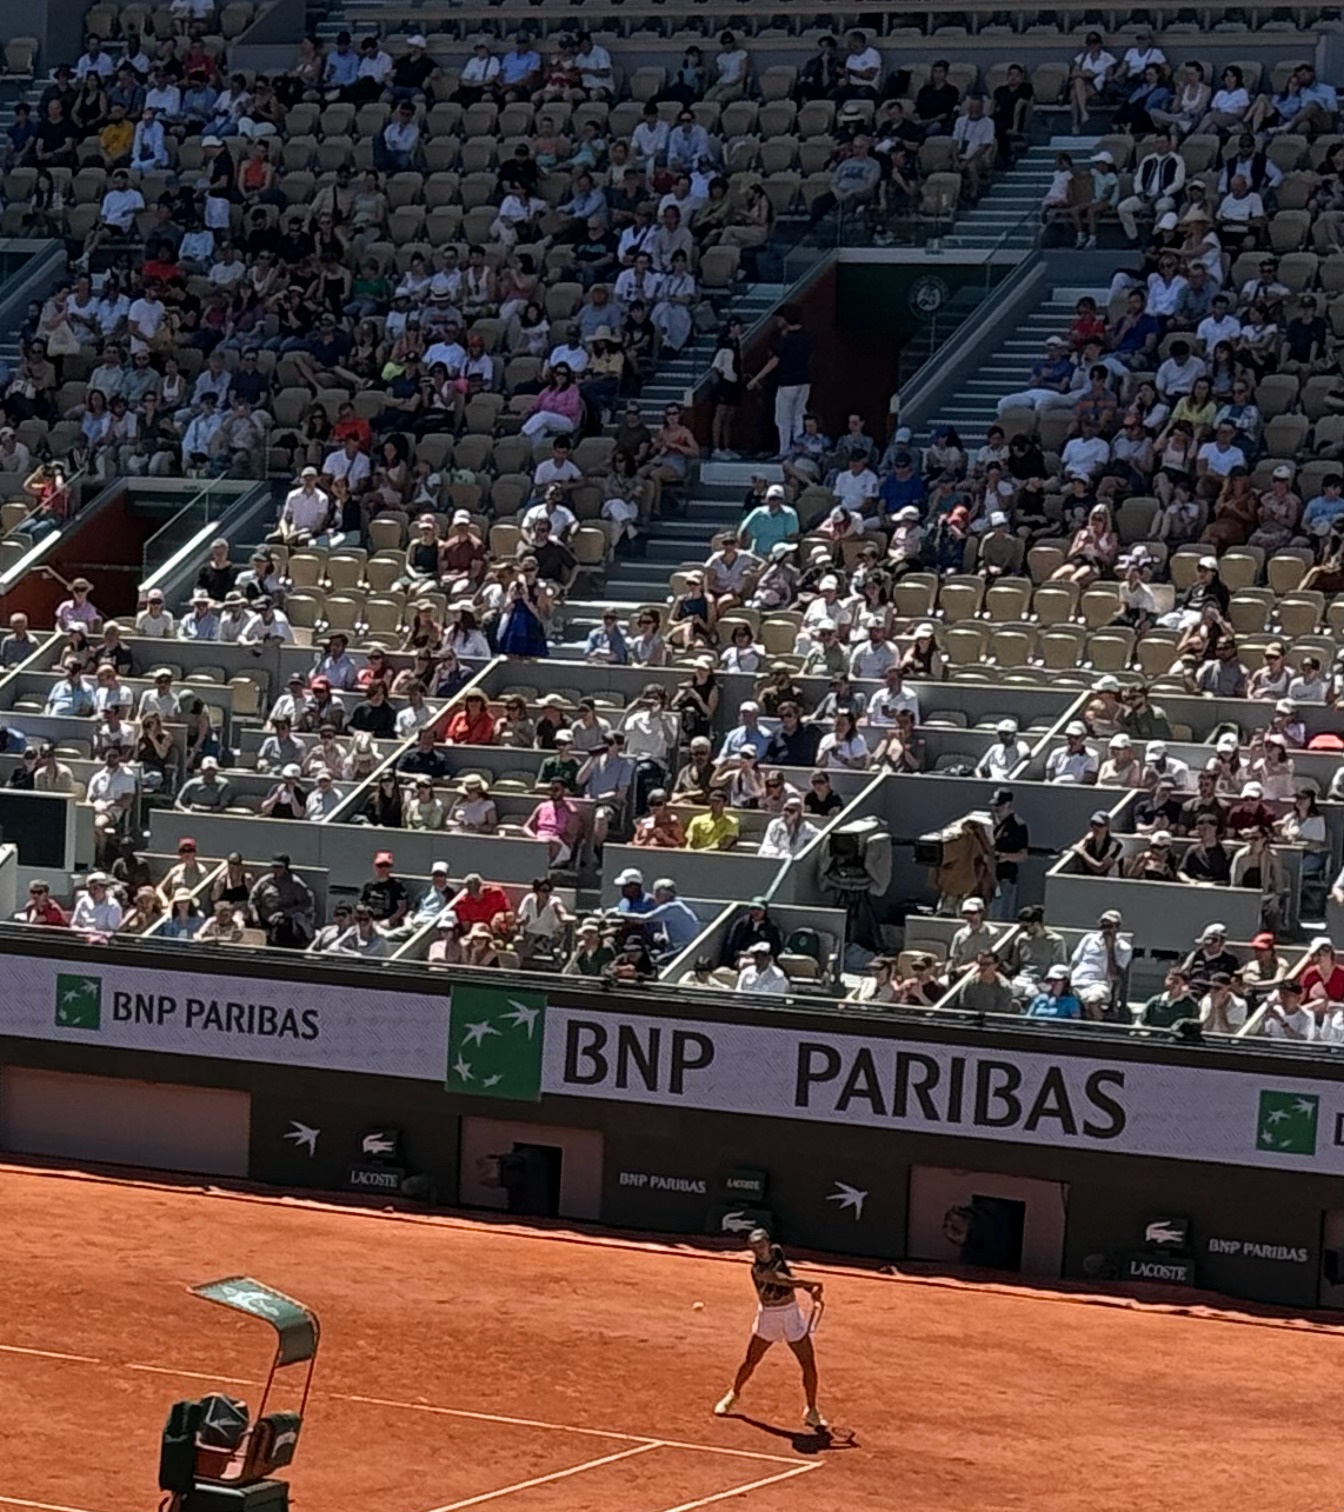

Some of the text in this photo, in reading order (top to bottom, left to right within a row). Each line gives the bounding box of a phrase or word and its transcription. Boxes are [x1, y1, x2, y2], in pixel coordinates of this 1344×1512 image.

[112, 991, 320, 1041] BNP PARIBAS
[563, 1018, 1127, 1140] BNP PARIBAS
[350, 1169, 398, 1188] LACOSTE
[619, 1172, 707, 1195] BNP PARIBAS
[1209, 1238, 1309, 1263] BNP PARIBAS
[1129, 1259, 1188, 1282] LACOSTE
